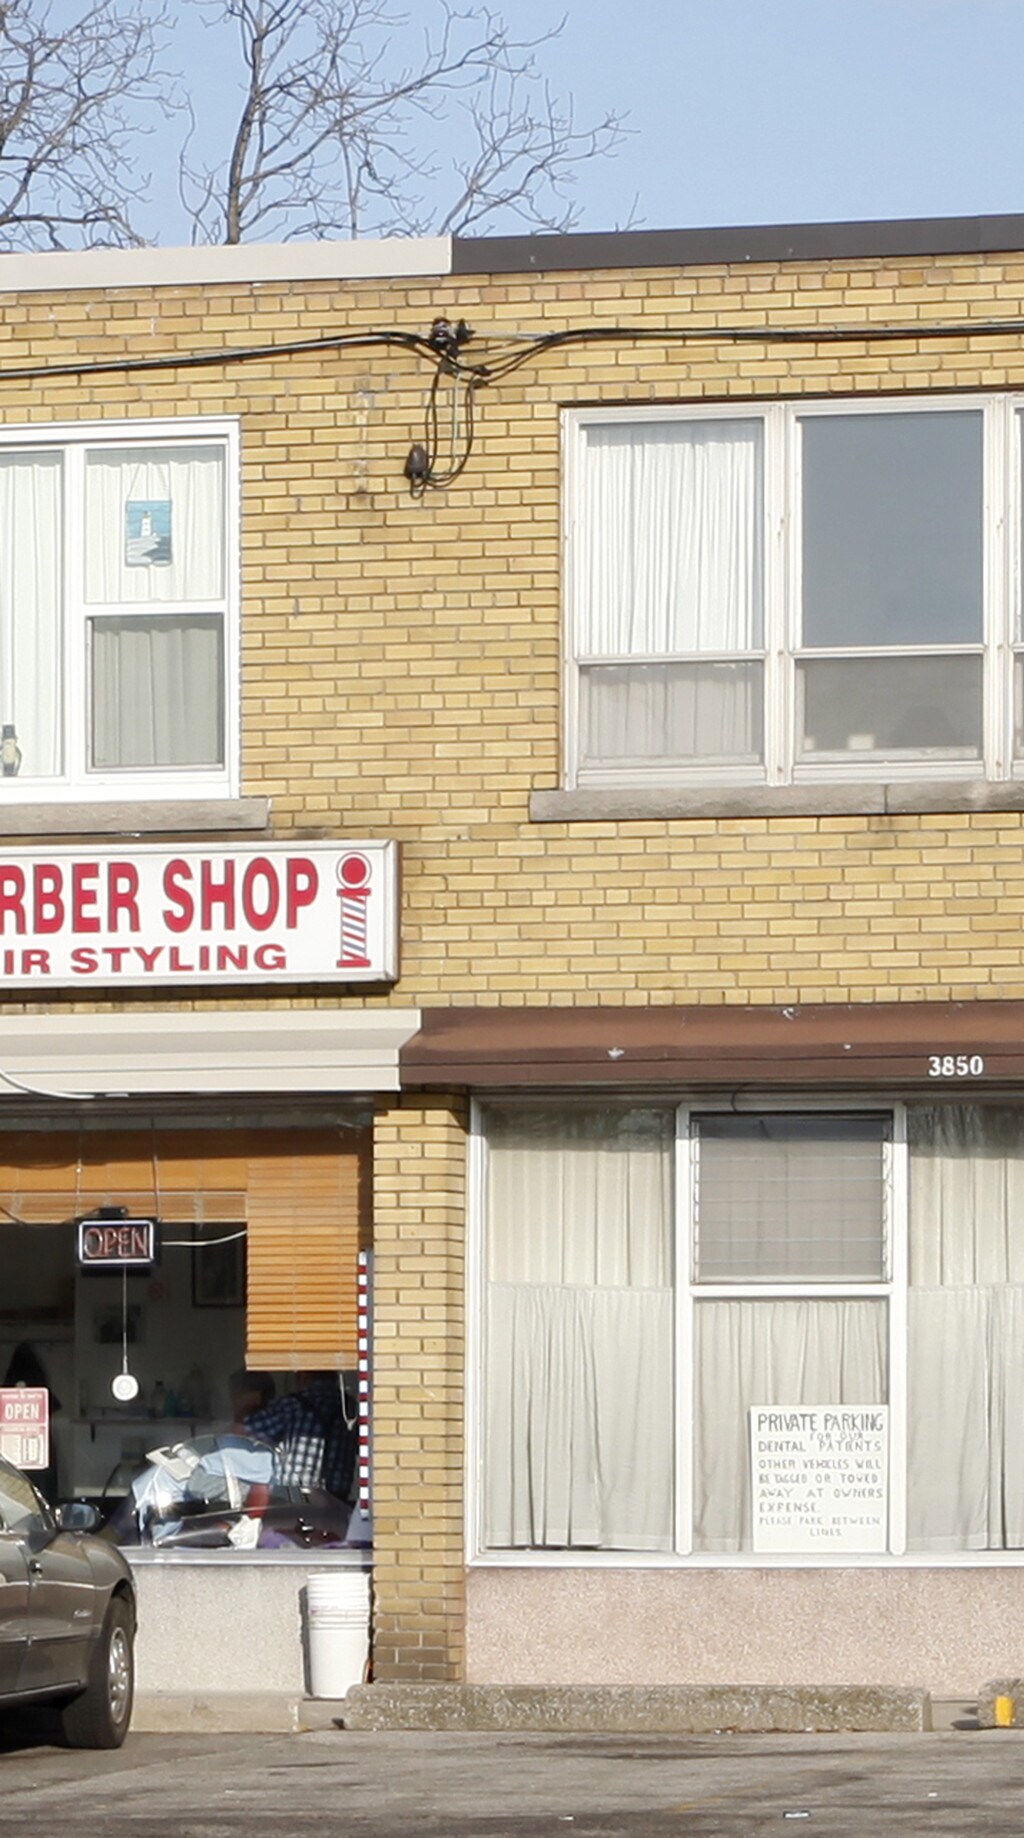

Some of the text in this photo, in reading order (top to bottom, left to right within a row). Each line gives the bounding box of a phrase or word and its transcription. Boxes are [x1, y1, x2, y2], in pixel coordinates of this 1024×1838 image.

[162, 856, 319, 932] SHOP
[3, 943, 287, 975] IR STYLING
[928, 1055, 984, 1077] 3850
[84, 1226, 148, 1258] OPEN
[4, 1403, 40, 1420] OPEN
[757, 1413, 884, 1432] PRIVATE PARKING
[757, 1440, 807, 1452] DENTAL
[758, 1459, 796, 1470] OTHER
[758, 1473, 770, 1484] BE
[814, 1473, 831, 1484] OR
[840, 1473, 879, 1484] TOWED
[759, 1488, 884, 1499] AWAY AT OWNERS
[758, 1517, 792, 1526] PLEASE
[832, 1517, 881, 1526] BETWEEN
